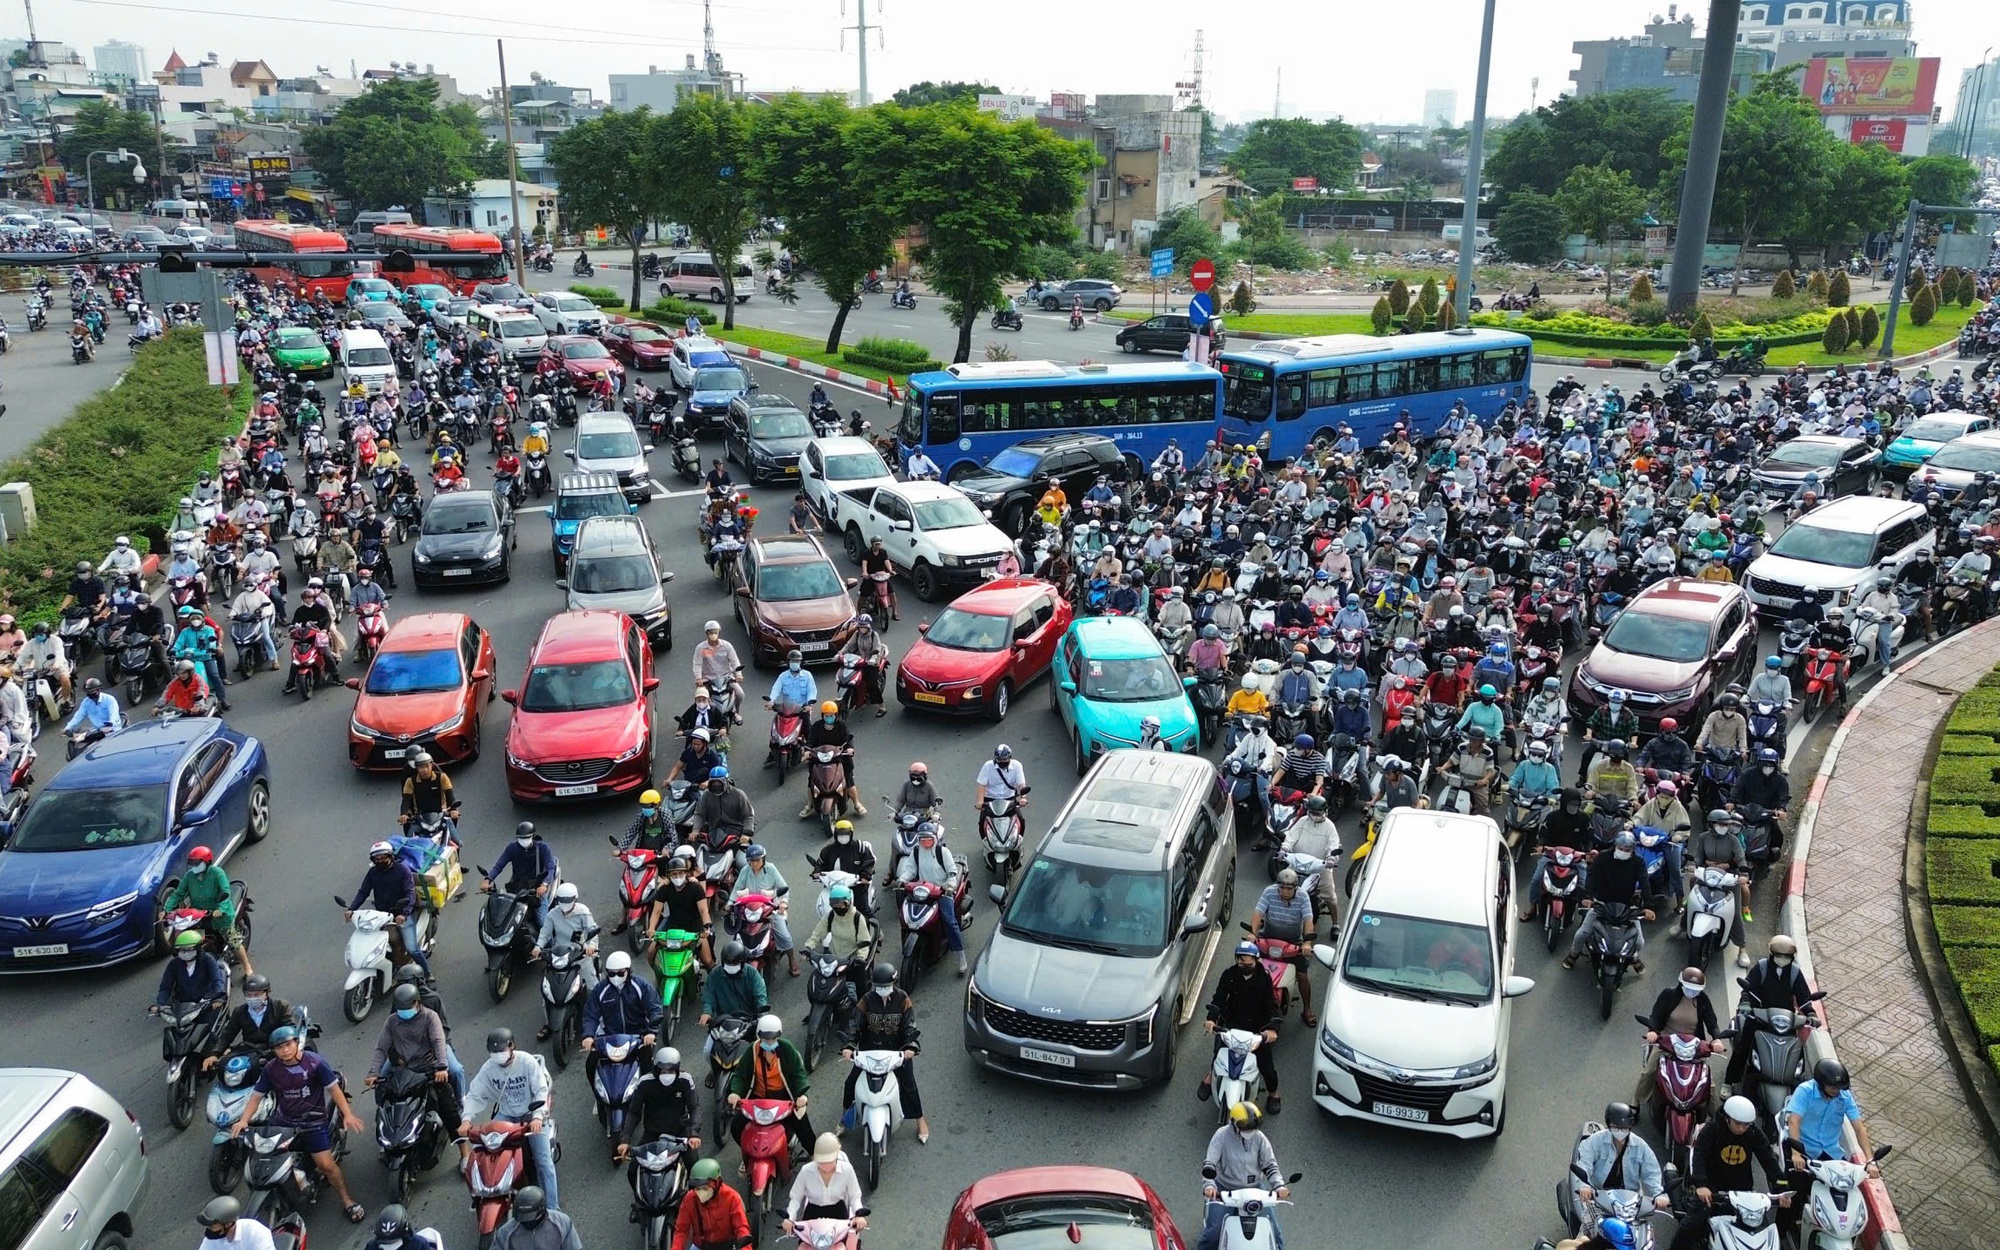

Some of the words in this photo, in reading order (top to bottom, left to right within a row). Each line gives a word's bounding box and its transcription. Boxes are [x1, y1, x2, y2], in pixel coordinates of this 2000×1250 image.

[996, 100, 1007, 108] LED
[1024, 1050, 1071, 1065] 51L-847.93
[1374, 1103, 1427, 1121] 51G-993.37
